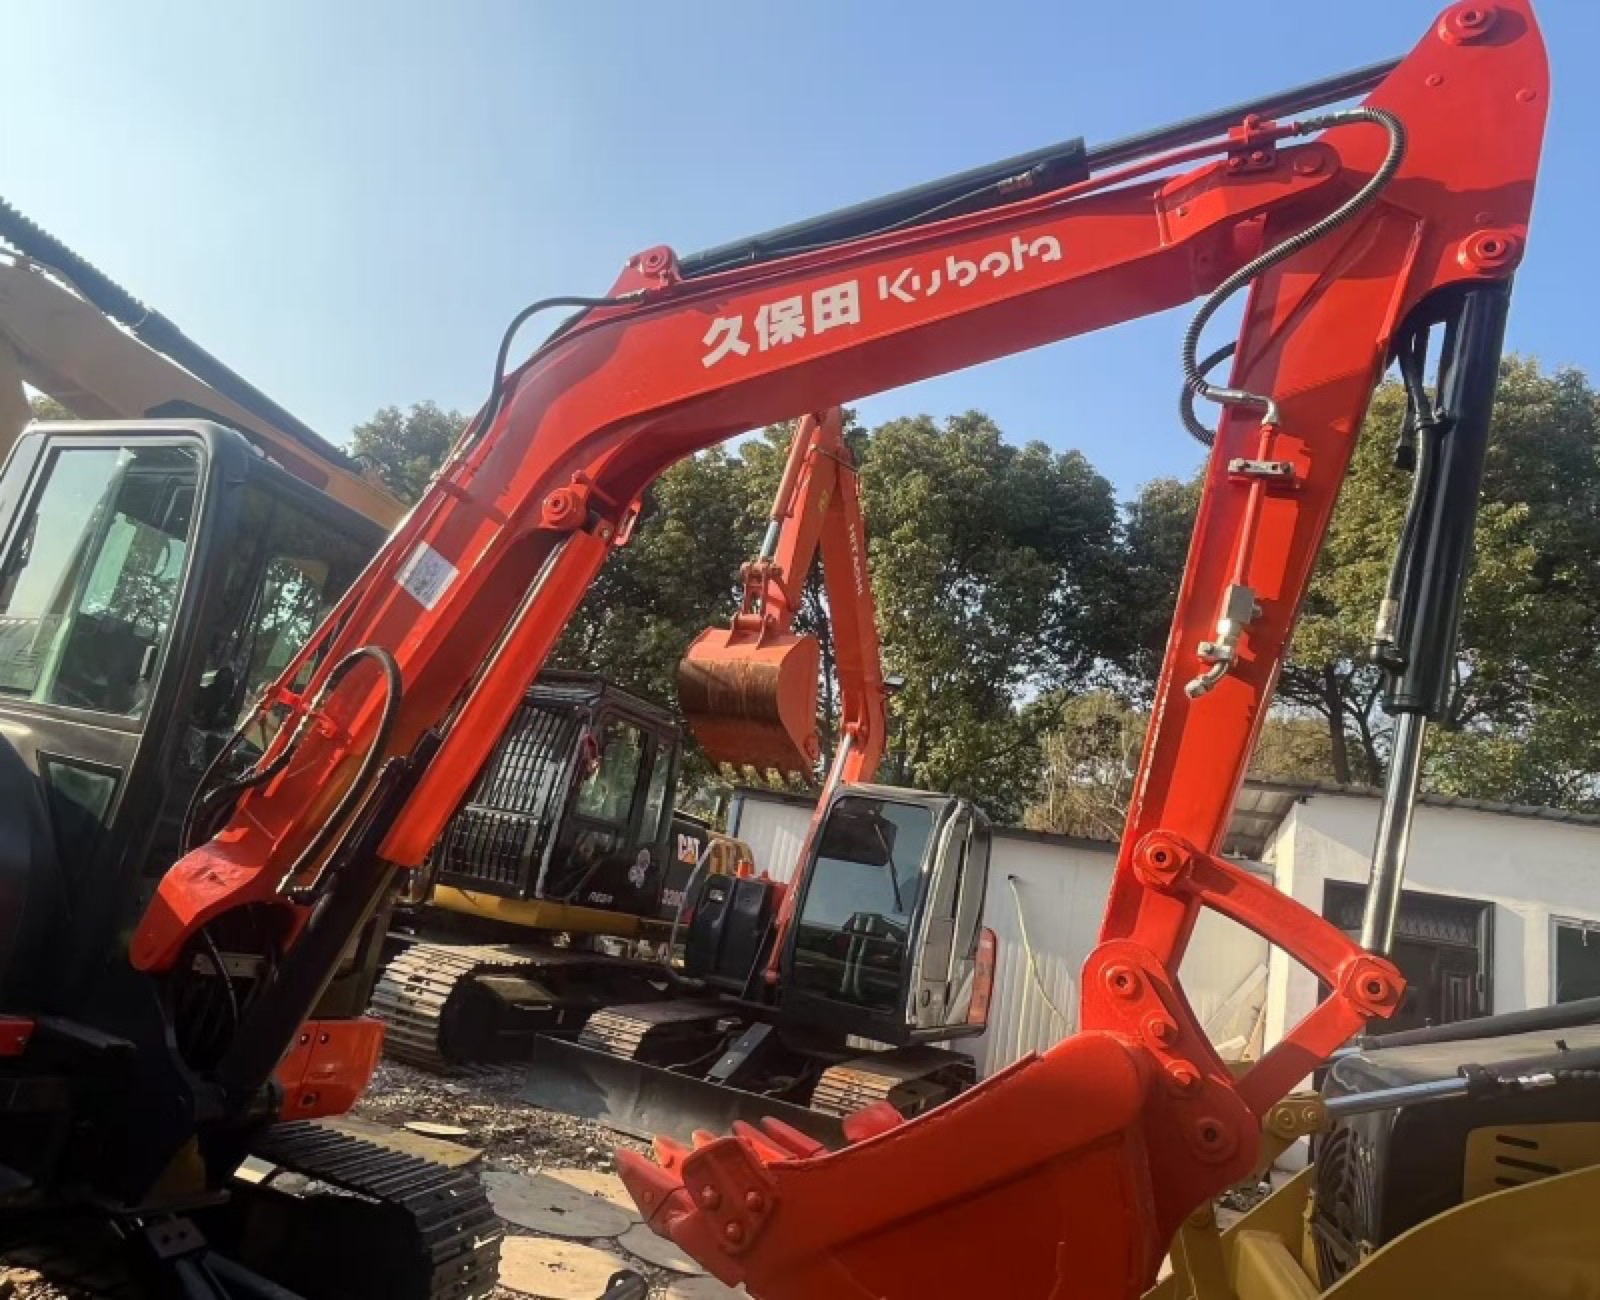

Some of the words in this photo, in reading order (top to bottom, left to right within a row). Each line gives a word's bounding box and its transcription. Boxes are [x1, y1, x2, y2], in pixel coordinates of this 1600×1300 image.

[702, 280, 861, 368] 久保田
[877, 235, 1062, 303] Kubota
[677, 834, 700, 864] CAT
